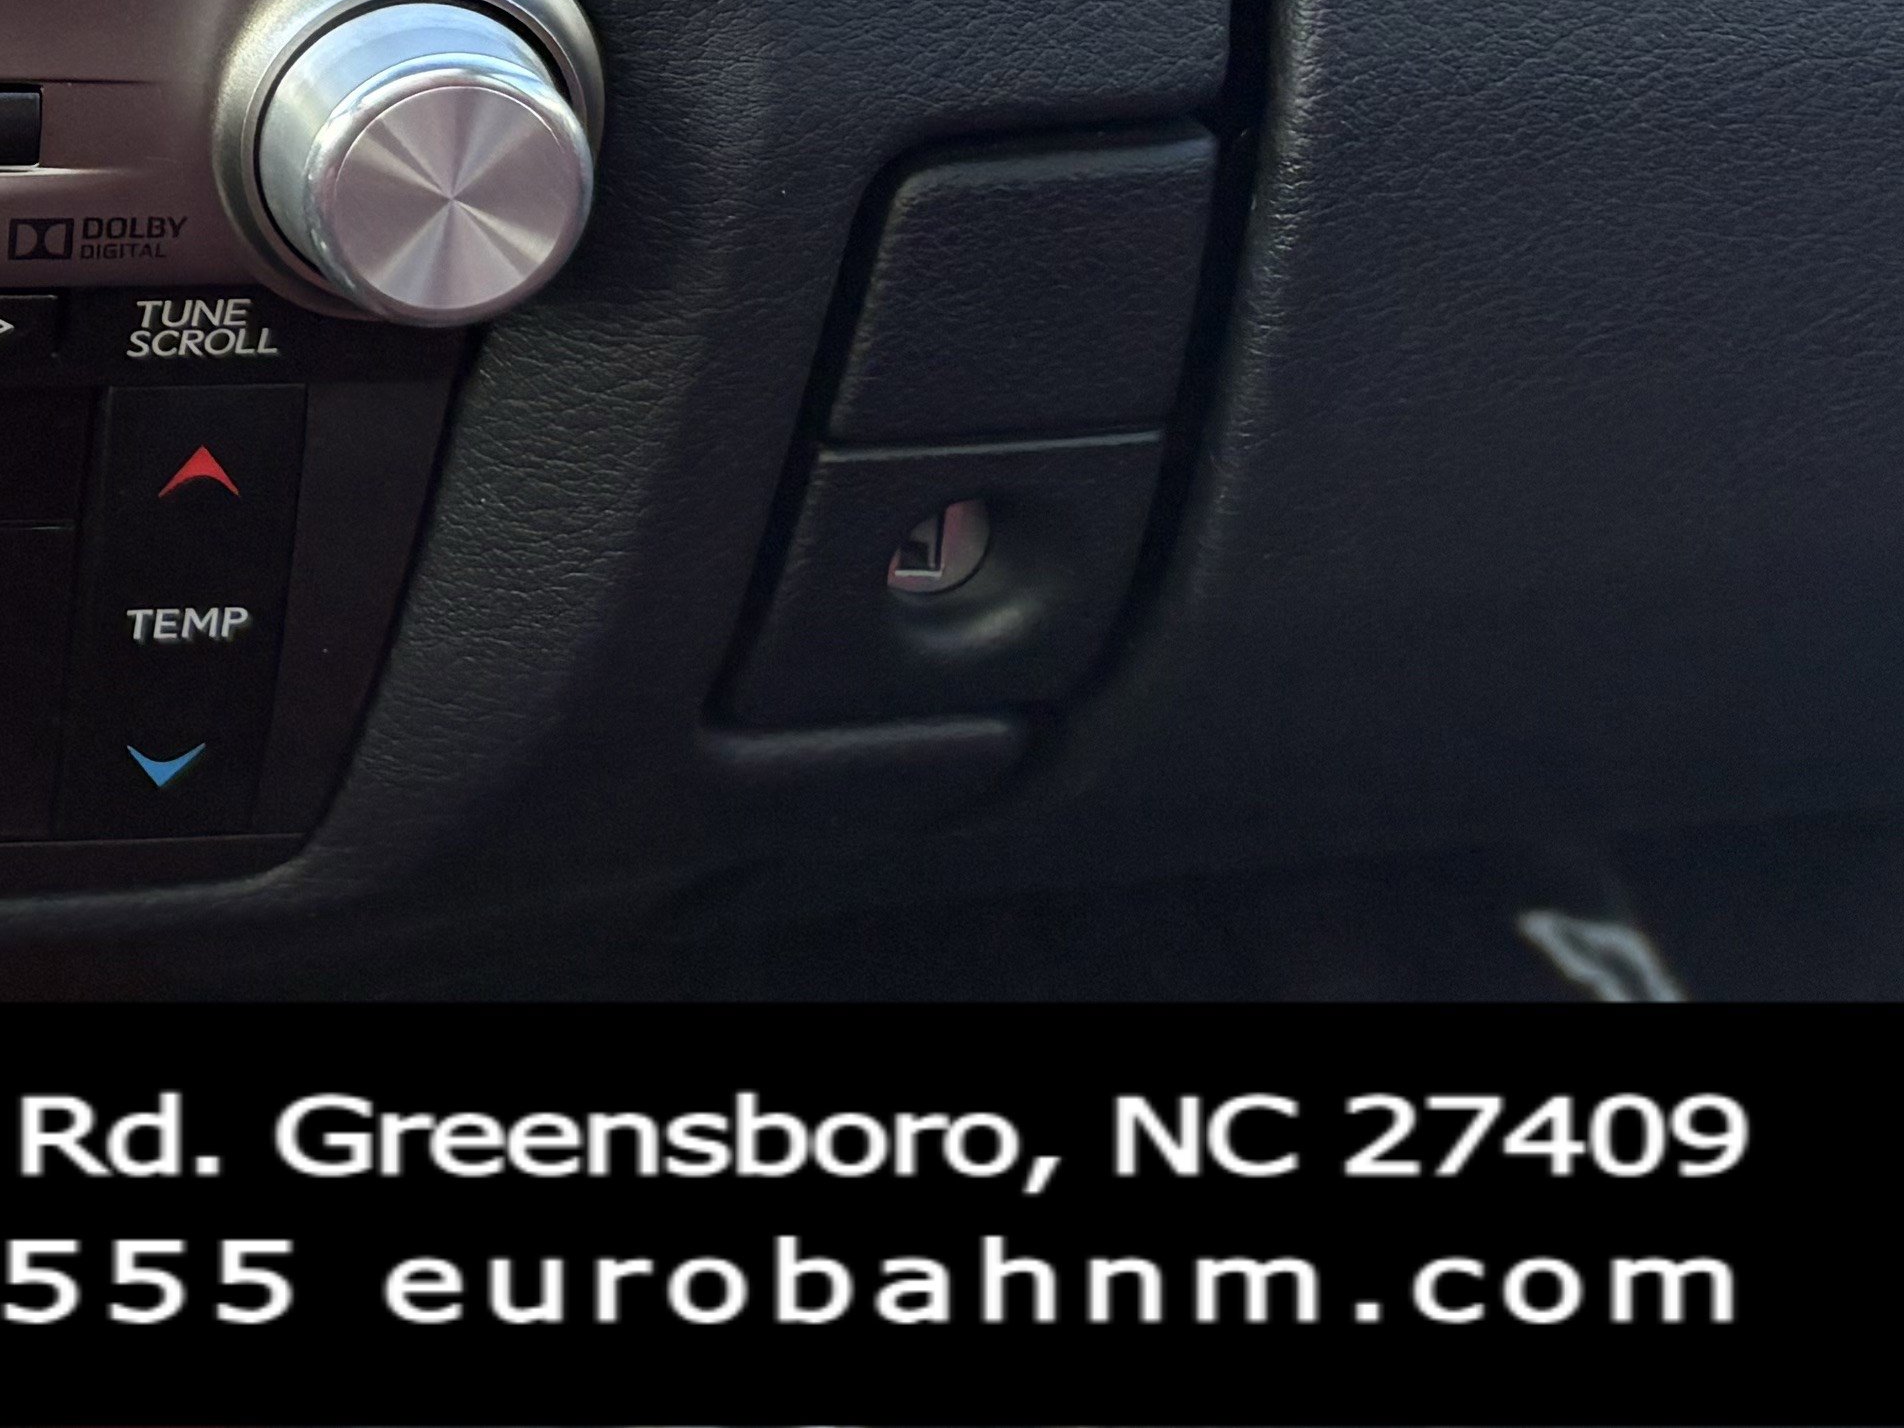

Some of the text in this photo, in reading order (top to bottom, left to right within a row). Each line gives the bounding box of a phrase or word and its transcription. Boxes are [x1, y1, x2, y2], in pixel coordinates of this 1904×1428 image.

[81, 216, 188, 240] DOLBY
[79, 242, 168, 260] DIGITAL
[136, 298, 253, 328] TUNE
[126, 326, 279, 358] SCROLL
[126, 606, 250, 642] TEMP
